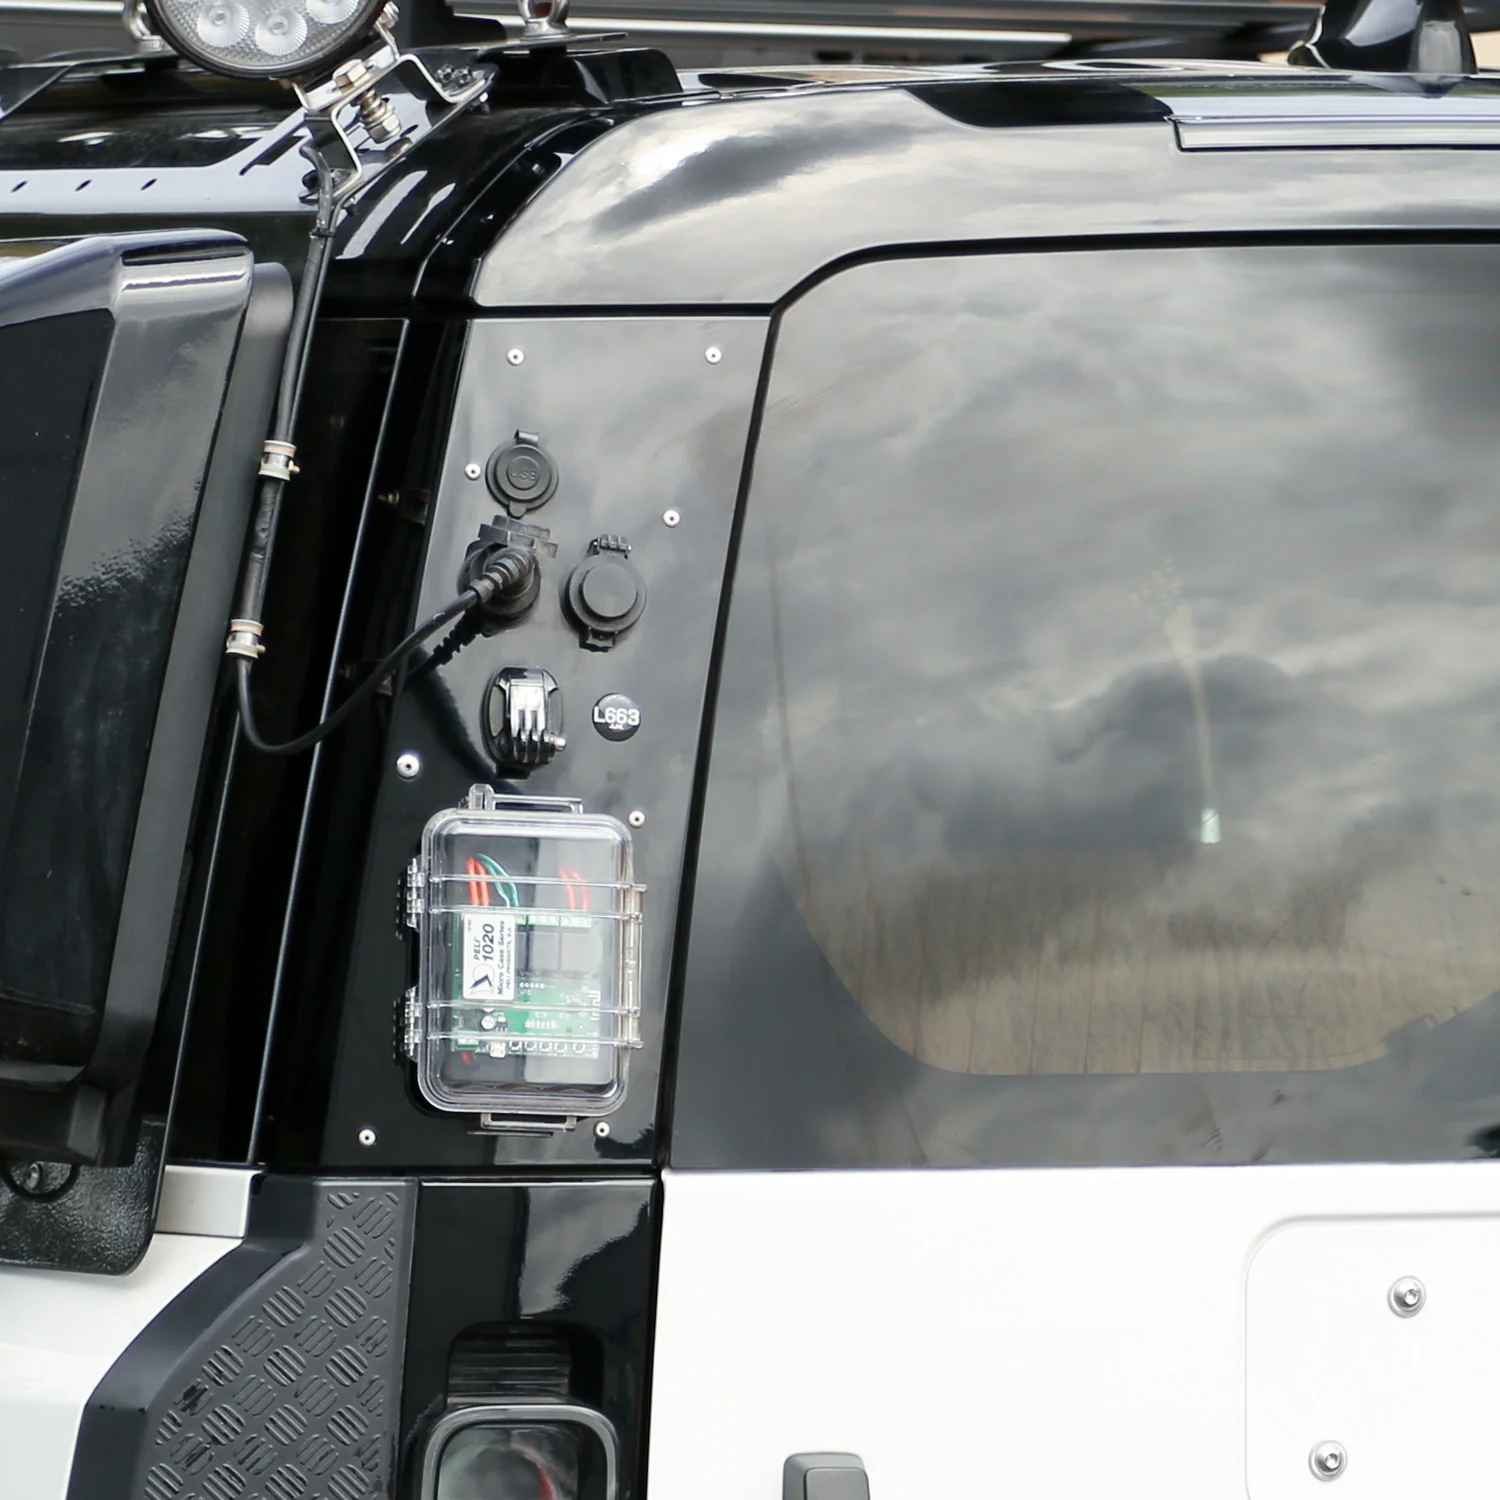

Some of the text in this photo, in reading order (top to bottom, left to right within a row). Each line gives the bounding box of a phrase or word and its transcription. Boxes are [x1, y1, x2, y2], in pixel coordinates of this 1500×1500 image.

[593, 706, 641, 726] L663
[473, 939, 481, 961] PELI
[482, 923, 495, 961] 1020
[497, 920, 505, 995] Micro Case Series
